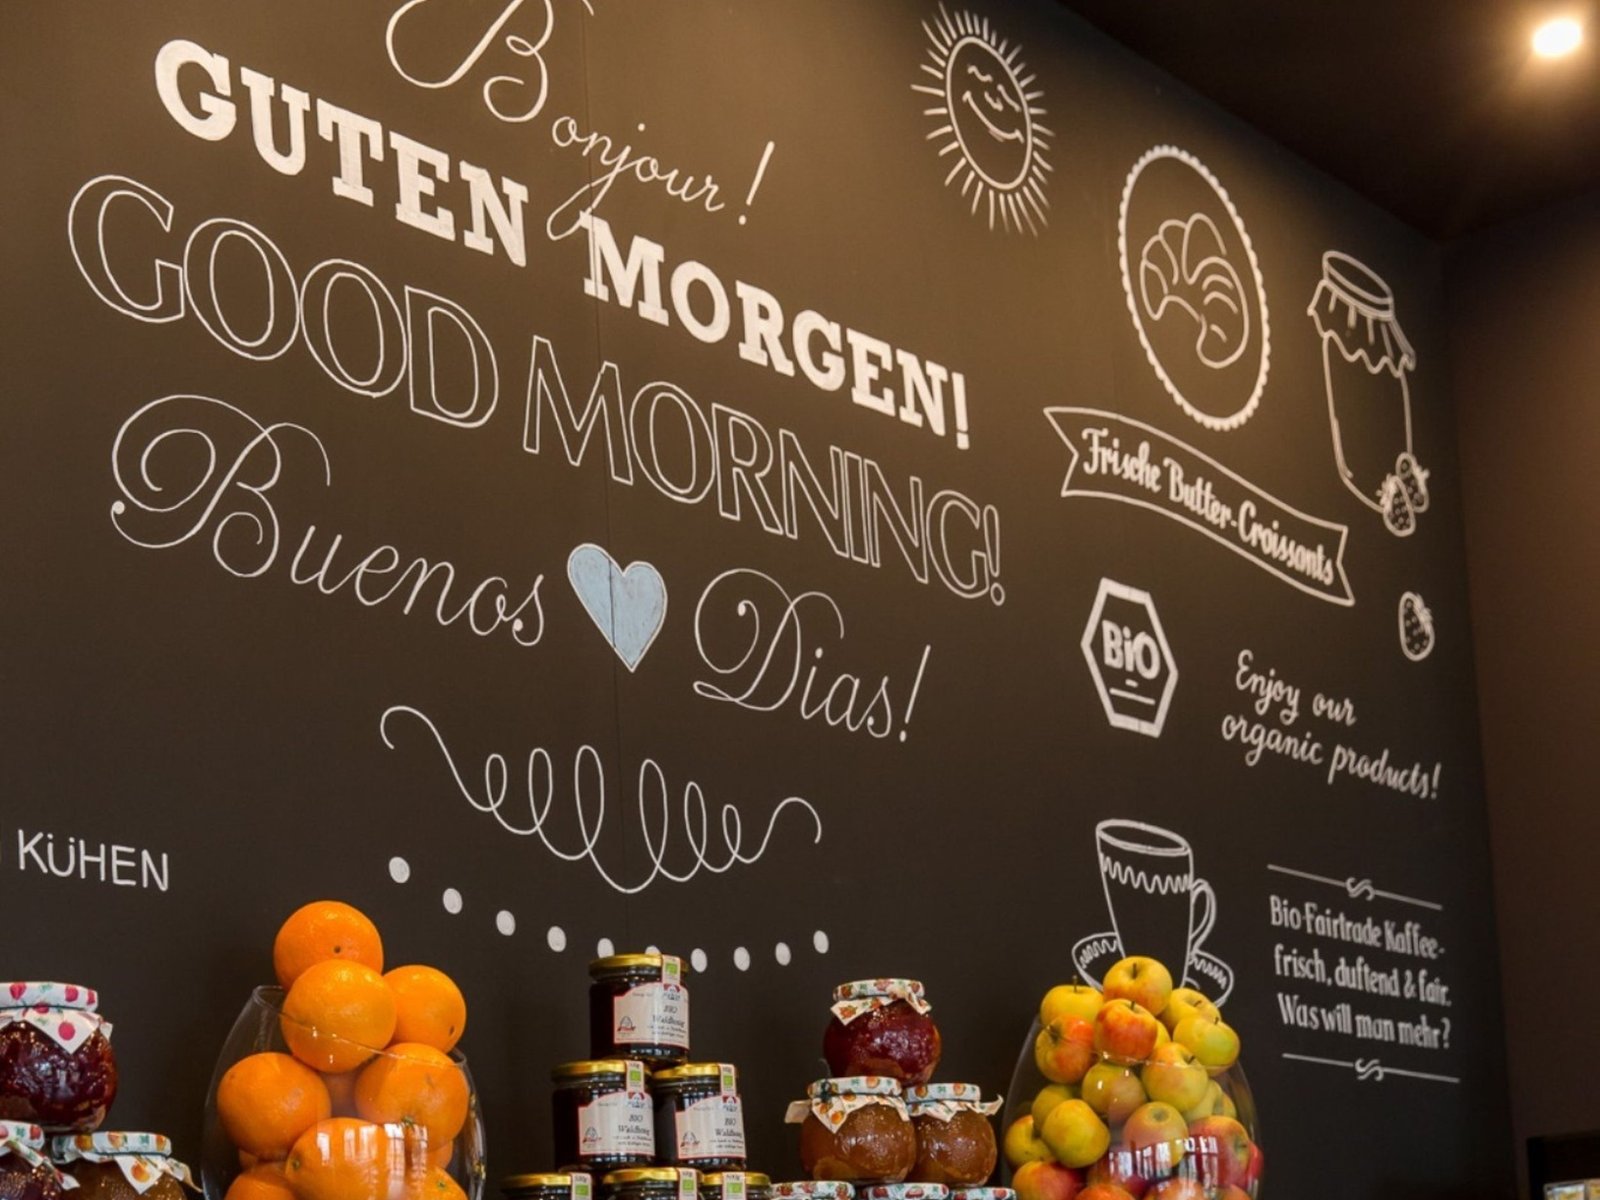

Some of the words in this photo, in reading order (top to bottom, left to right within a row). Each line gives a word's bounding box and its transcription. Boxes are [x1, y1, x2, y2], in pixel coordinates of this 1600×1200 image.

[155, 39, 530, 267] GUTEN
[578, 208, 970, 450] MORGEN!
[68, 174, 500, 429] GOOD
[522, 334, 1006, 606] MORNING!
[1081, 427, 1162, 494] Frische
[1162, 456, 1335, 587] Butter-Croissants
[110, 394, 545, 646] Buenos
[693, 567, 931, 742] Dias!
[1235, 649, 1300, 724] Enjoy
[1312, 691, 1357, 727] our
[1221, 713, 1324, 767] organic
[1327, 748, 1442, 800] products!
[17, 829, 170, 892] KÜHEN
[1277, 991, 1320, 1030] Was
[1320, 1002, 1352, 1035] will
[1355, 1014, 1395, 1042] man
[1397, 1013, 1452, 1050] mehr?
[1334, 955, 1400, 998] duftend
[1403, 969, 1417, 999] &
[1418, 968, 1452, 1007] fair.
